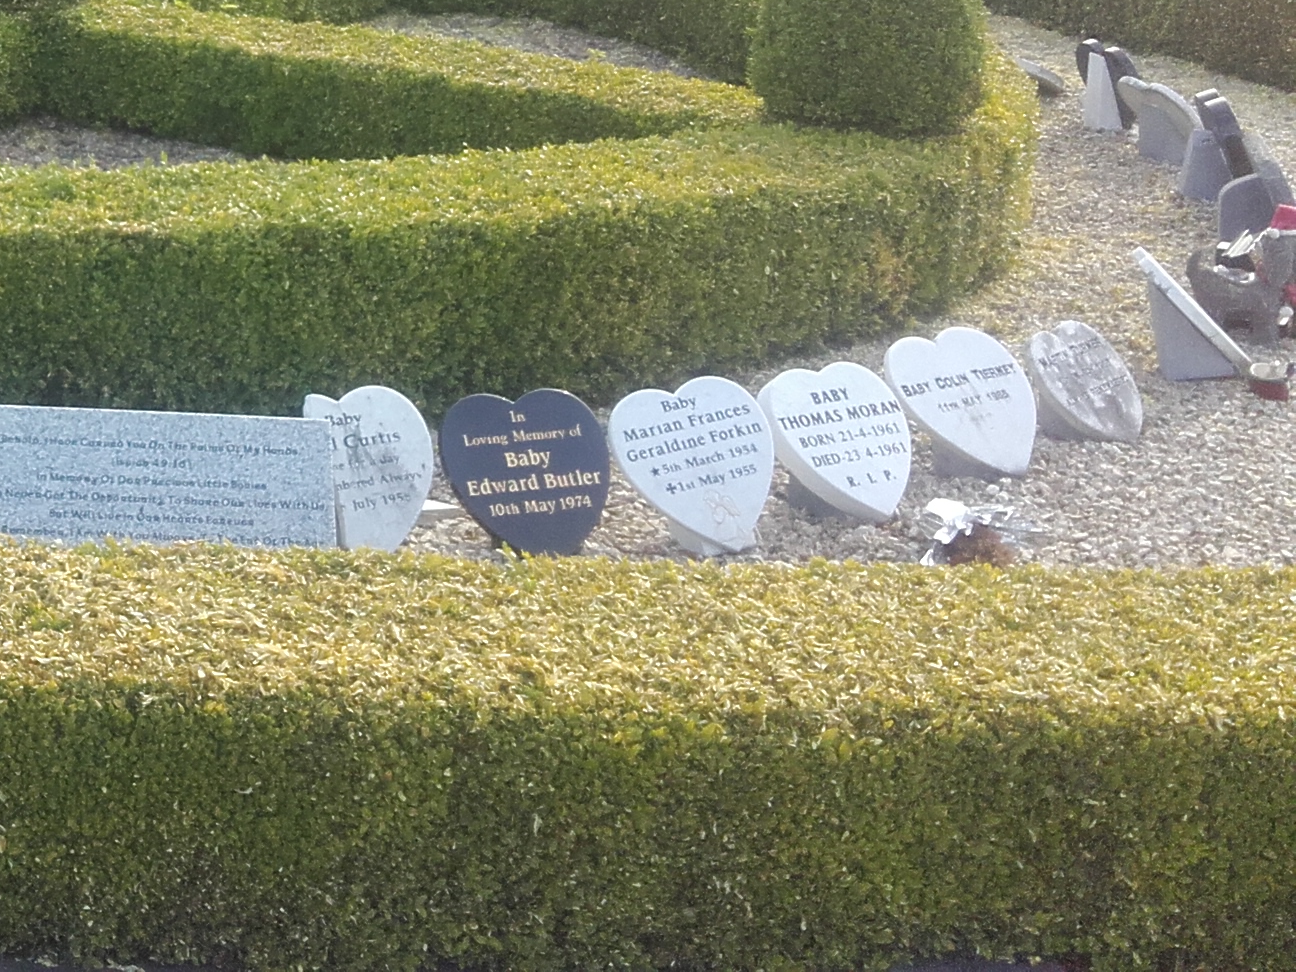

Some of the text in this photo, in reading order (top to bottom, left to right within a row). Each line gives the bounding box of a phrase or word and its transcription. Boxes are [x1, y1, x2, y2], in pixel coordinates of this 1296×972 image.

[900, 362, 1015, 397] BABY COLIN TIERNEY
[660, 396, 696, 413] Baby
[809, 388, 849, 405] BABY
[961, 394, 983, 407] MAY
[509, 410, 526, 423] In
[623, 404, 750, 443] Marian Frances
[778, 400, 901, 431] THOMAS MORAN
[344, 432, 401, 449] Curtis
[463, 424, 582, 447] Loving Memory of
[626, 422, 763, 462] Geraldine Forkin
[798, 422, 901, 449] BORN 21-4-1961
[504, 448, 551, 468] Baby
[685, 451, 725, 469] March
[729, 443, 758, 458] 1954
[467, 469, 601, 496] Edward Butler
[698, 473, 725, 486] May
[729, 464, 757, 479] 1955
[352, 497, 377, 512] July
[489, 495, 592, 517] 10th May 1974
